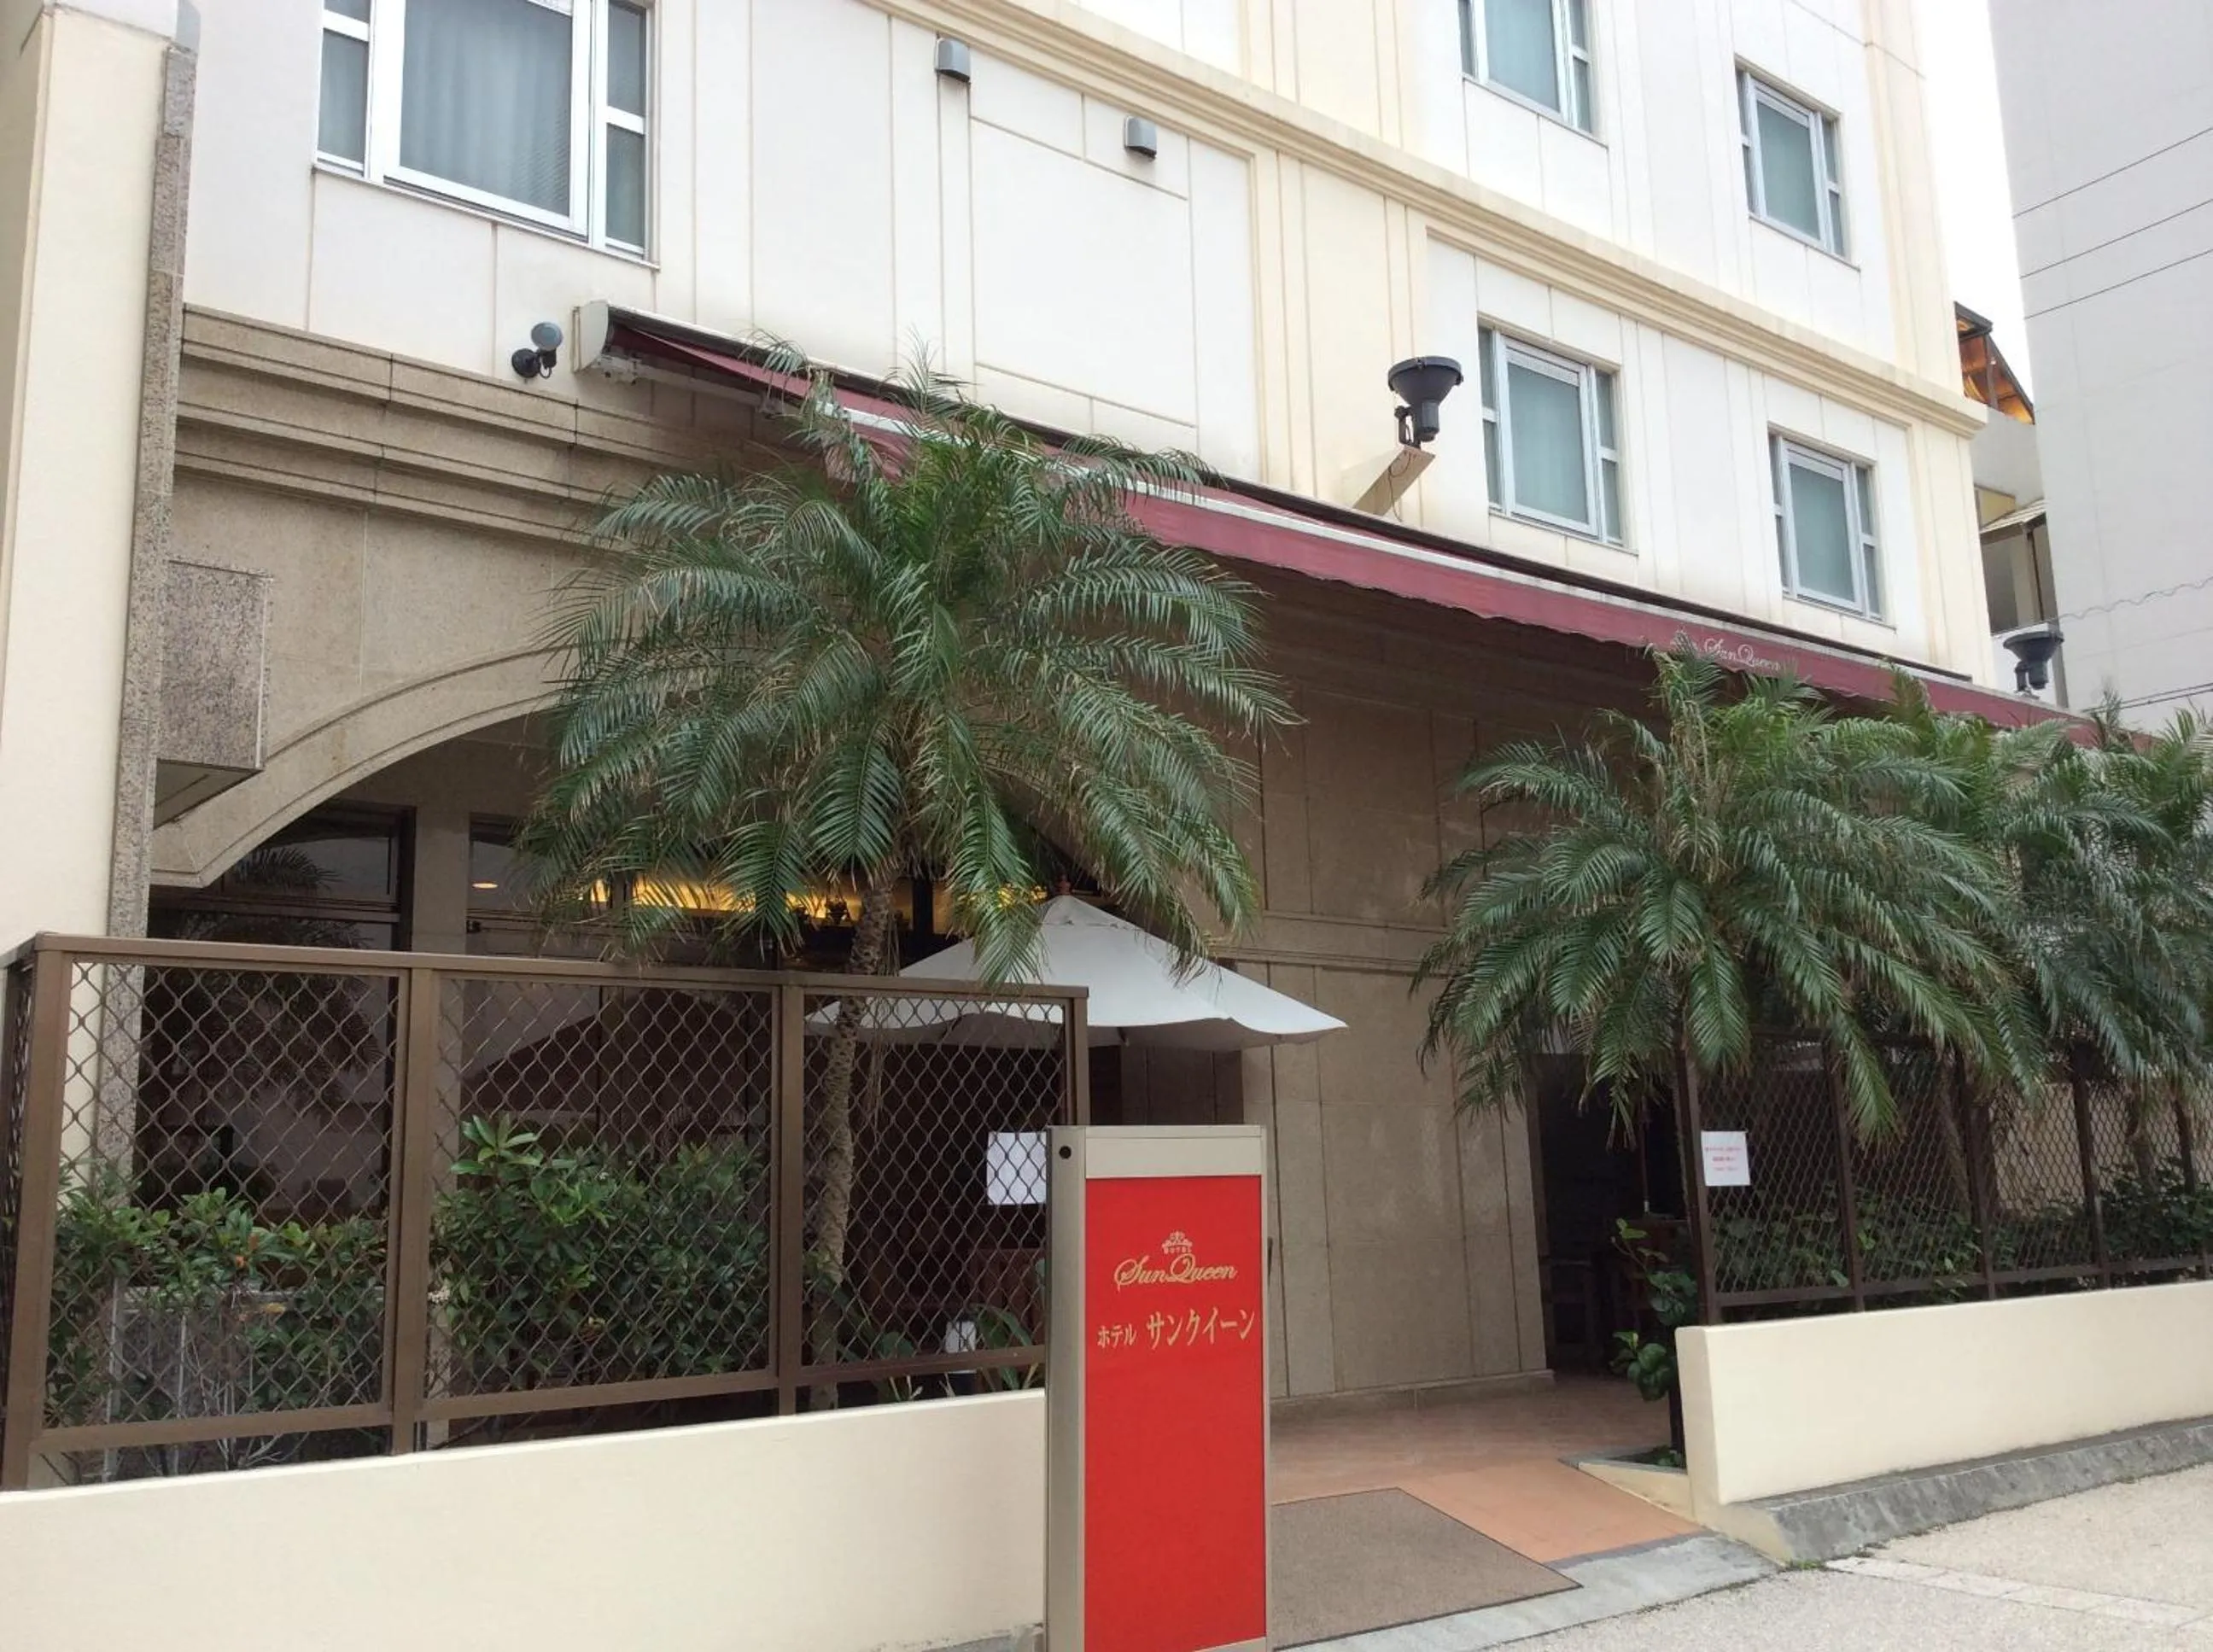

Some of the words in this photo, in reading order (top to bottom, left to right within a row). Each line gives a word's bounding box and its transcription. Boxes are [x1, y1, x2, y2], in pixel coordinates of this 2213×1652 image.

[1097, 1323, 1137, 1349] ホテル
[1146, 1306, 1255, 1350] サンクイーン
